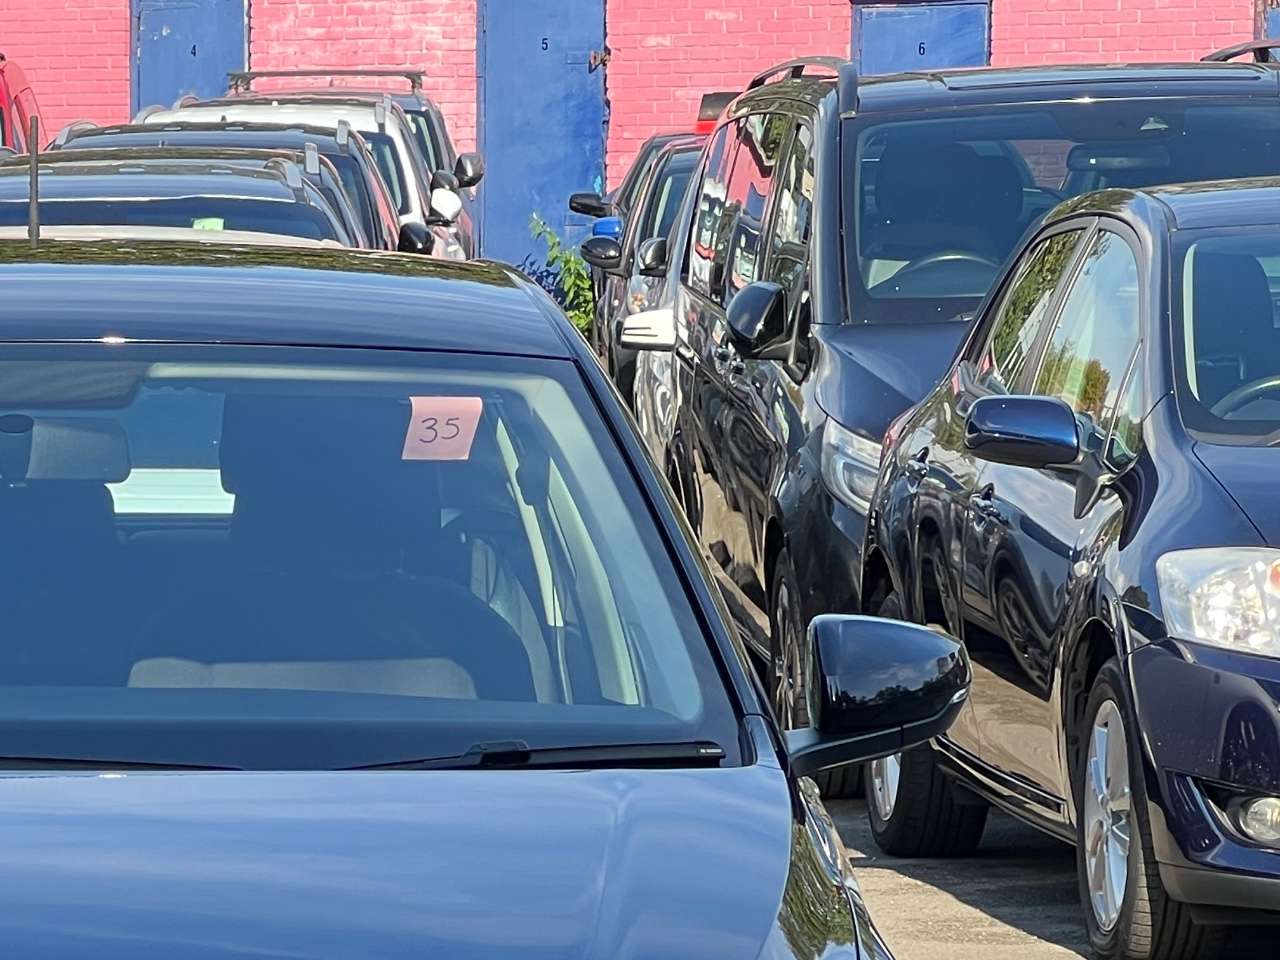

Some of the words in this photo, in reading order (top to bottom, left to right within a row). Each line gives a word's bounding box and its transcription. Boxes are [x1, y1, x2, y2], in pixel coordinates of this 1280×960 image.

[190, 44, 197, 57] 4
[541, 37, 549, 51] 5
[918, 41, 926, 56] 6
[419, 416, 461, 443] 35
